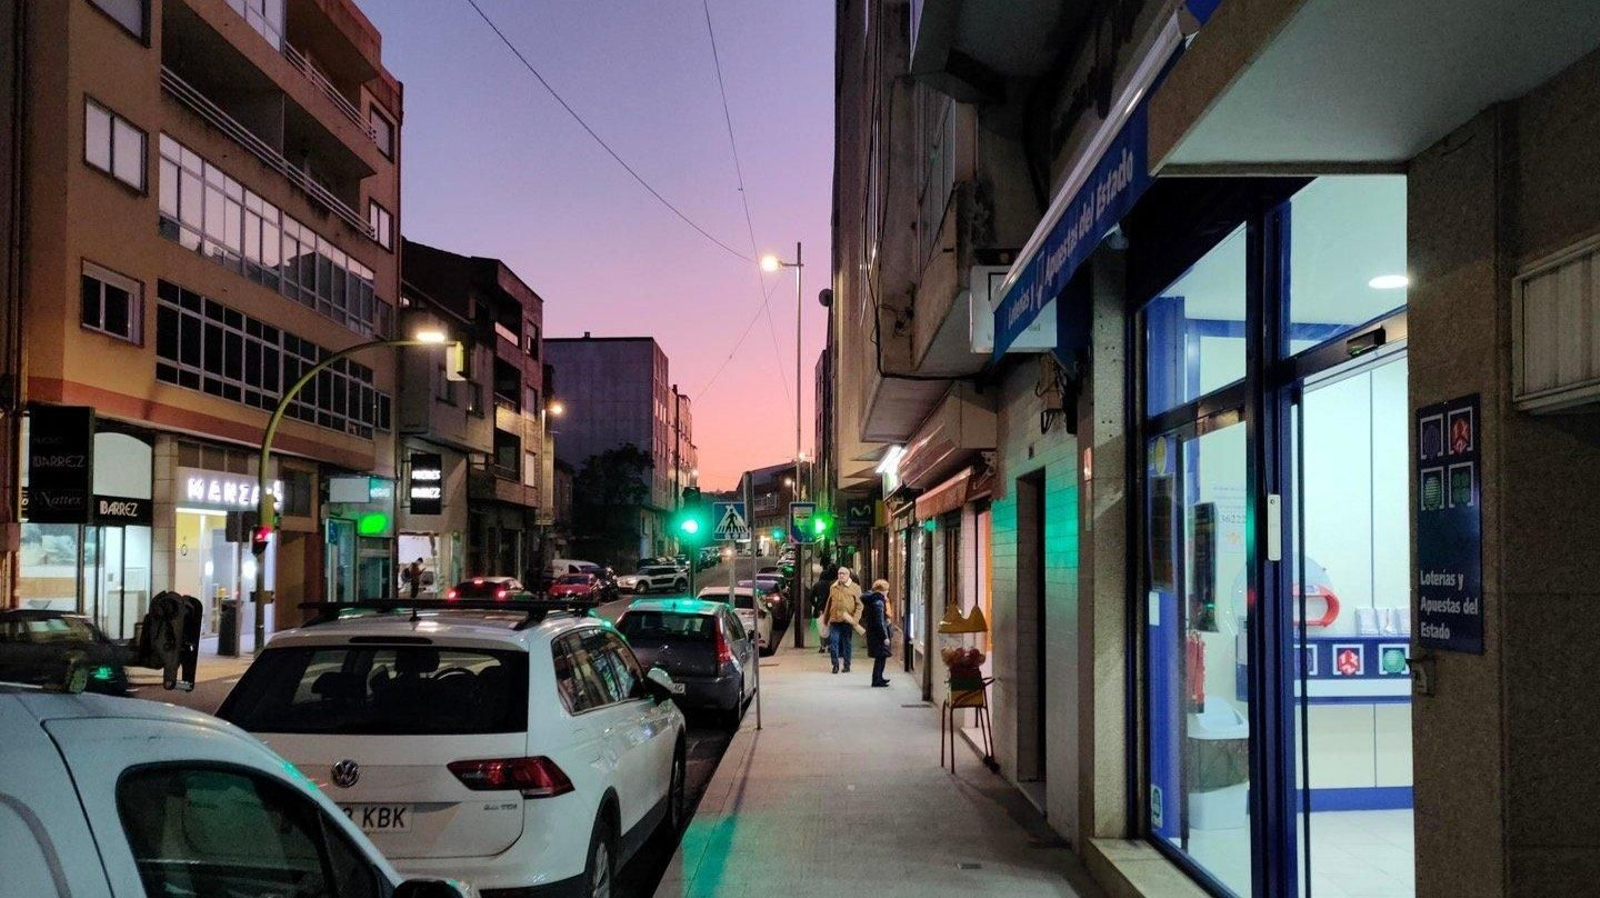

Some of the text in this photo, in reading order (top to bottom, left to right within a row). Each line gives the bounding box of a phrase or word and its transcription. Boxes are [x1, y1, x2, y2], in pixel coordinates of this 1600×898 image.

[1079, 192, 1095, 240] del
[1096, 147, 1133, 220] Estado
[1420, 568, 1464, 591] Loterías y
[1420, 596, 1478, 615] Apuestas del
[1420, 622, 1450, 640] Estado
[362, 806, 407, 828] KBK
